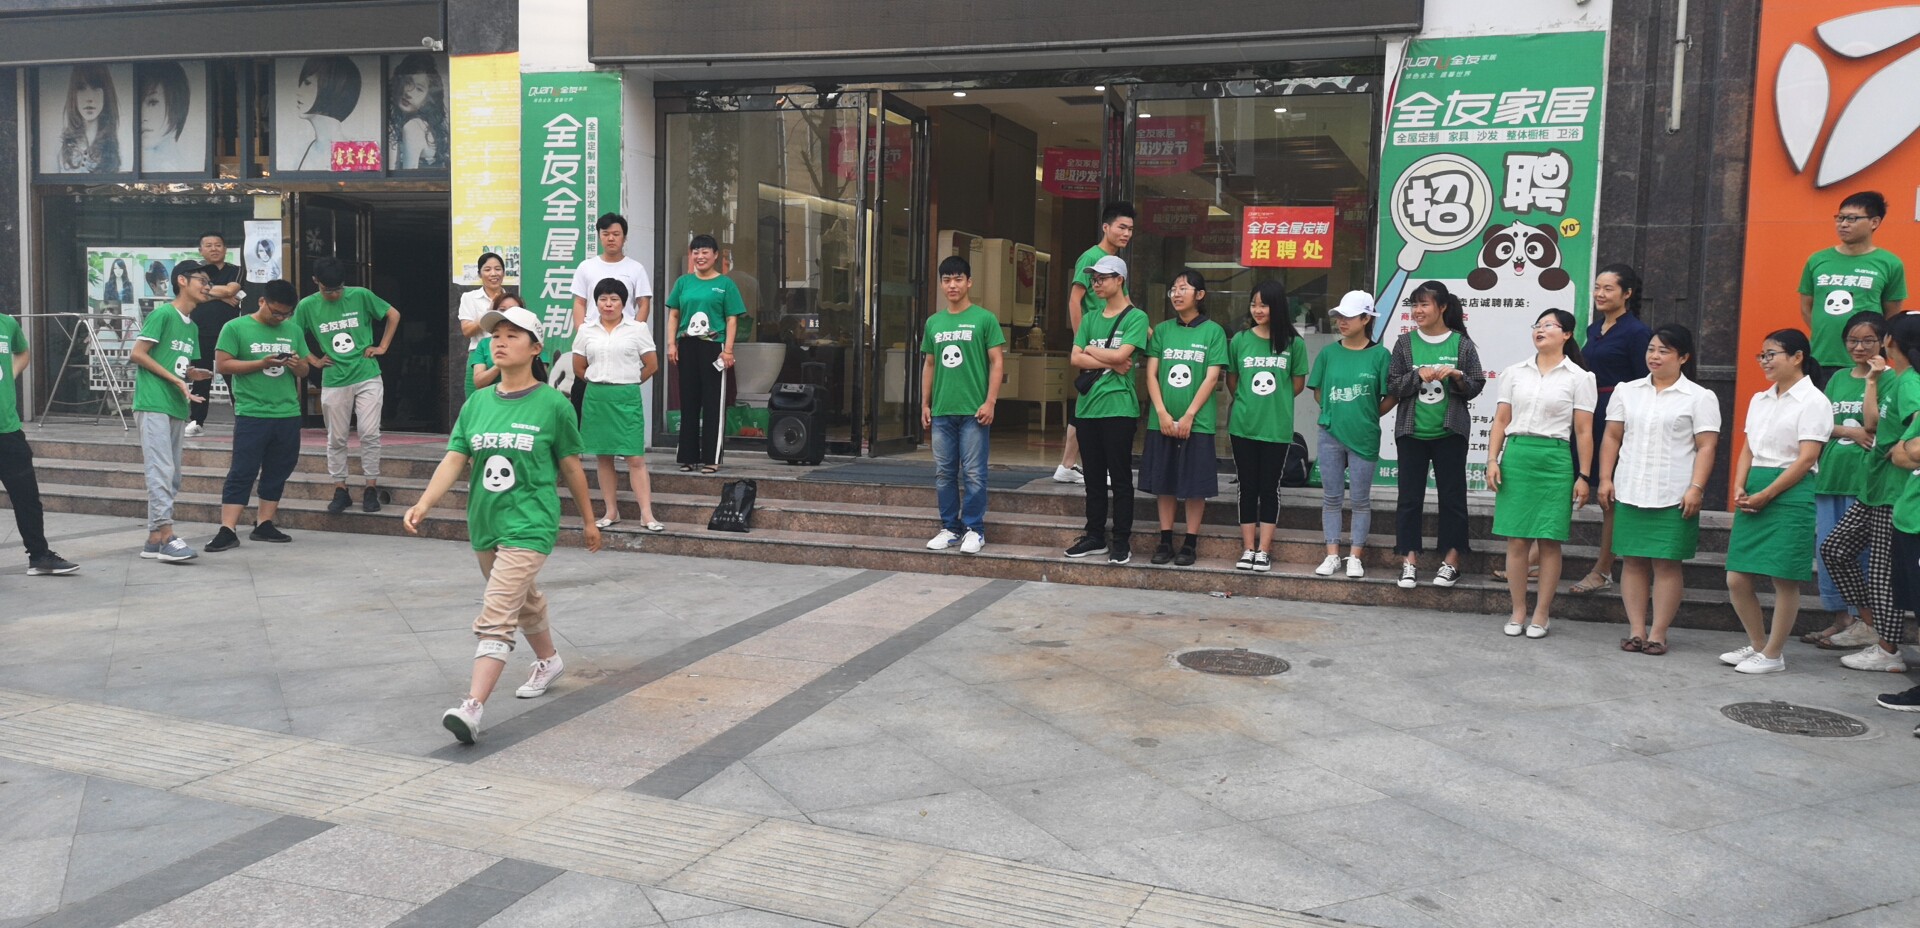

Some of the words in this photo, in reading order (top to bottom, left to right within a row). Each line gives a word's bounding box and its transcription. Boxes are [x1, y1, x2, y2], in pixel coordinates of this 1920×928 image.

[1393, 86, 1595, 128] 全友家居
[587, 121, 596, 161] 全屋定制
[1397, 132, 1439, 143] 全屋定制
[1448, 131, 1469, 142] 家具
[1477, 130, 1498, 141] 沙发
[1506, 129, 1549, 140] 整体橱柜
[1557, 128, 1579, 139] 卫浴
[587, 165, 596, 185] 家具
[587, 190, 596, 209] 沙发
[540, 112, 583, 338] 全友全屋定制
[1247, 221, 1330, 235] 全友全屋定制
[1250, 239, 1324, 259] 招聘处
[1816, 273, 1873, 289] 全友家居
[319, 317, 359, 333] 全友家居
[934, 329, 973, 343] 全友家居
[250, 342, 291, 354] 全友家居
[1163, 348, 1206, 363] 全友家居
[1243, 356, 1288, 370] 全友家居
[471, 432, 535, 452] 全友家居
